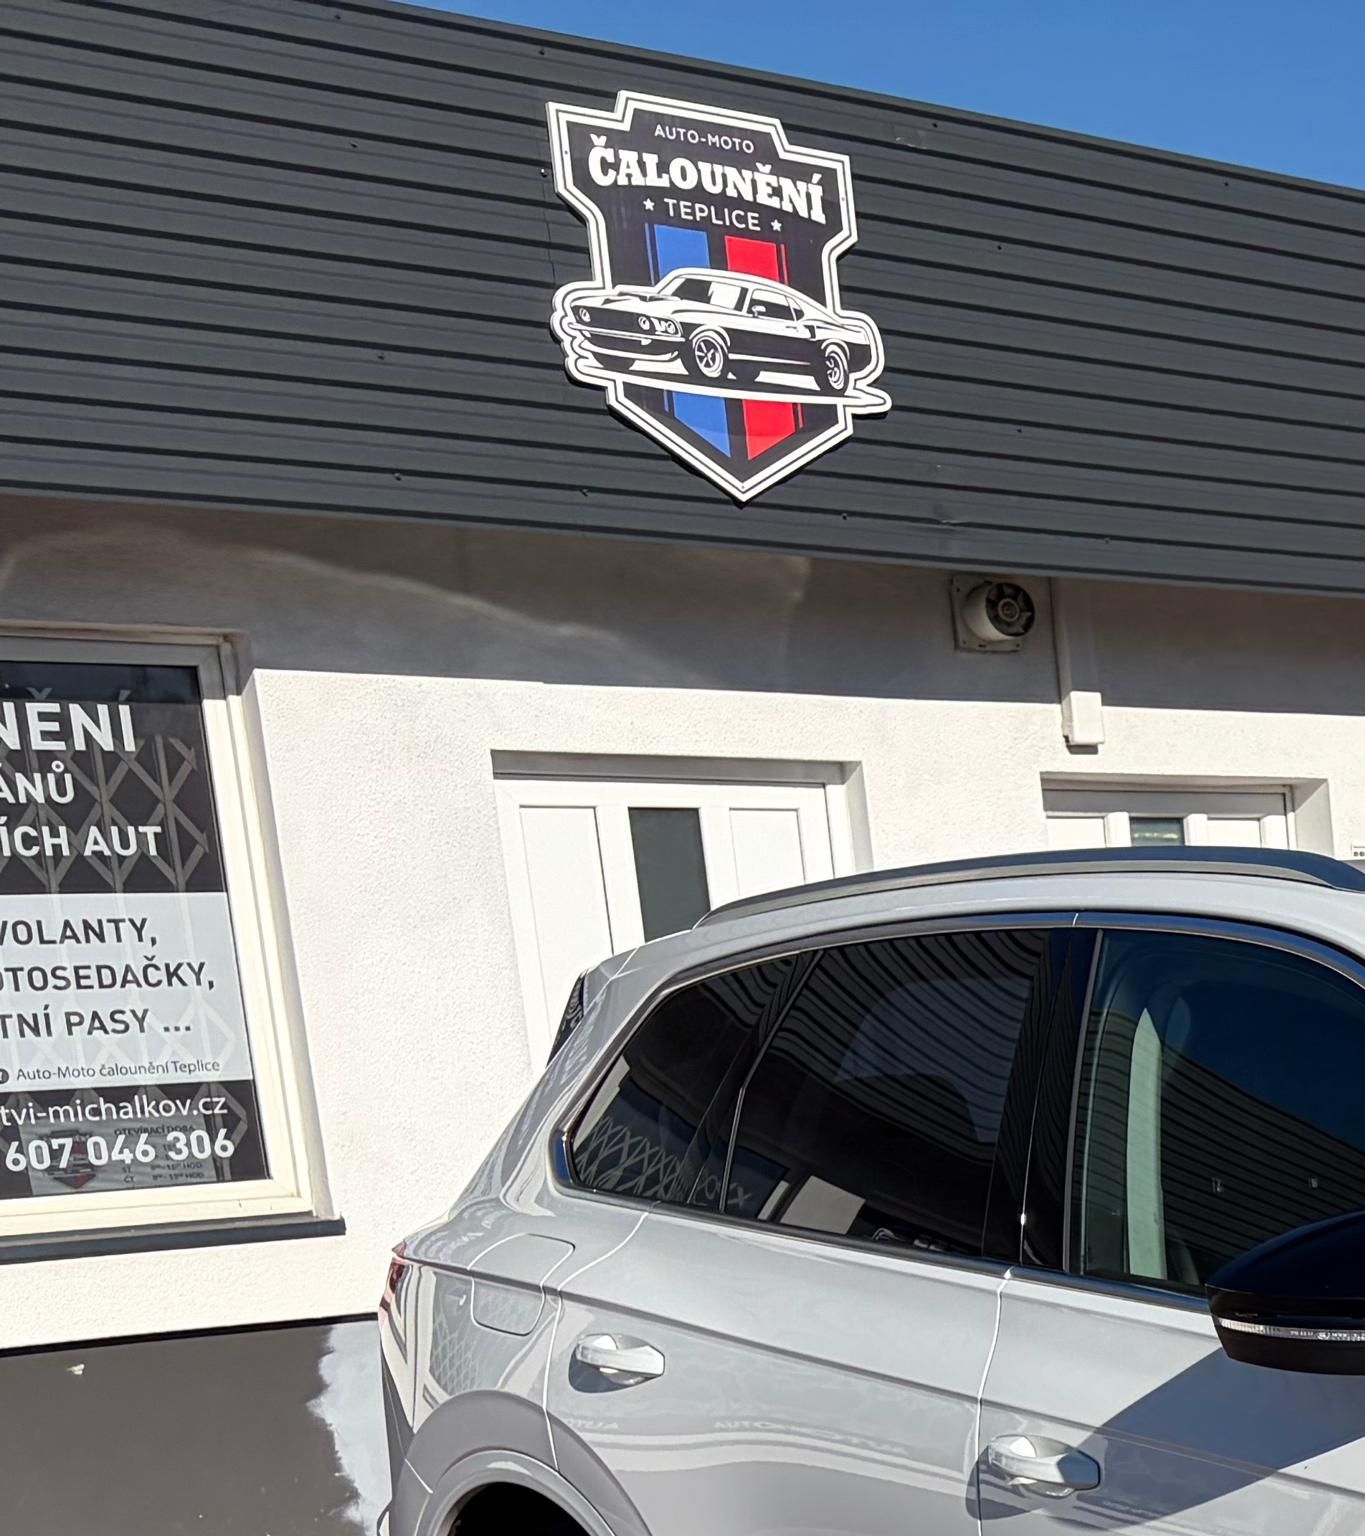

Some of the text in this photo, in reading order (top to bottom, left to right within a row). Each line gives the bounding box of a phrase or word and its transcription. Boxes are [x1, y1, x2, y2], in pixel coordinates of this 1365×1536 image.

[654, 124, 755, 154] AUTO-MOTO
[588, 133, 826, 225] ČALOUNĚNÍ
[664, 198, 761, 231] TEPLICE
[83, 825, 162, 857] AUT
[0, 955, 215, 992] TOSEDAČKY,
[64, 1009, 149, 1036] PASY
[16, 1059, 221, 1081] Auto-Moto čalounění Teplice
[5, 1138, 73, 1172] 607
[86, 1133, 156, 1166] 046
[166, 1128, 235, 1161] 306
